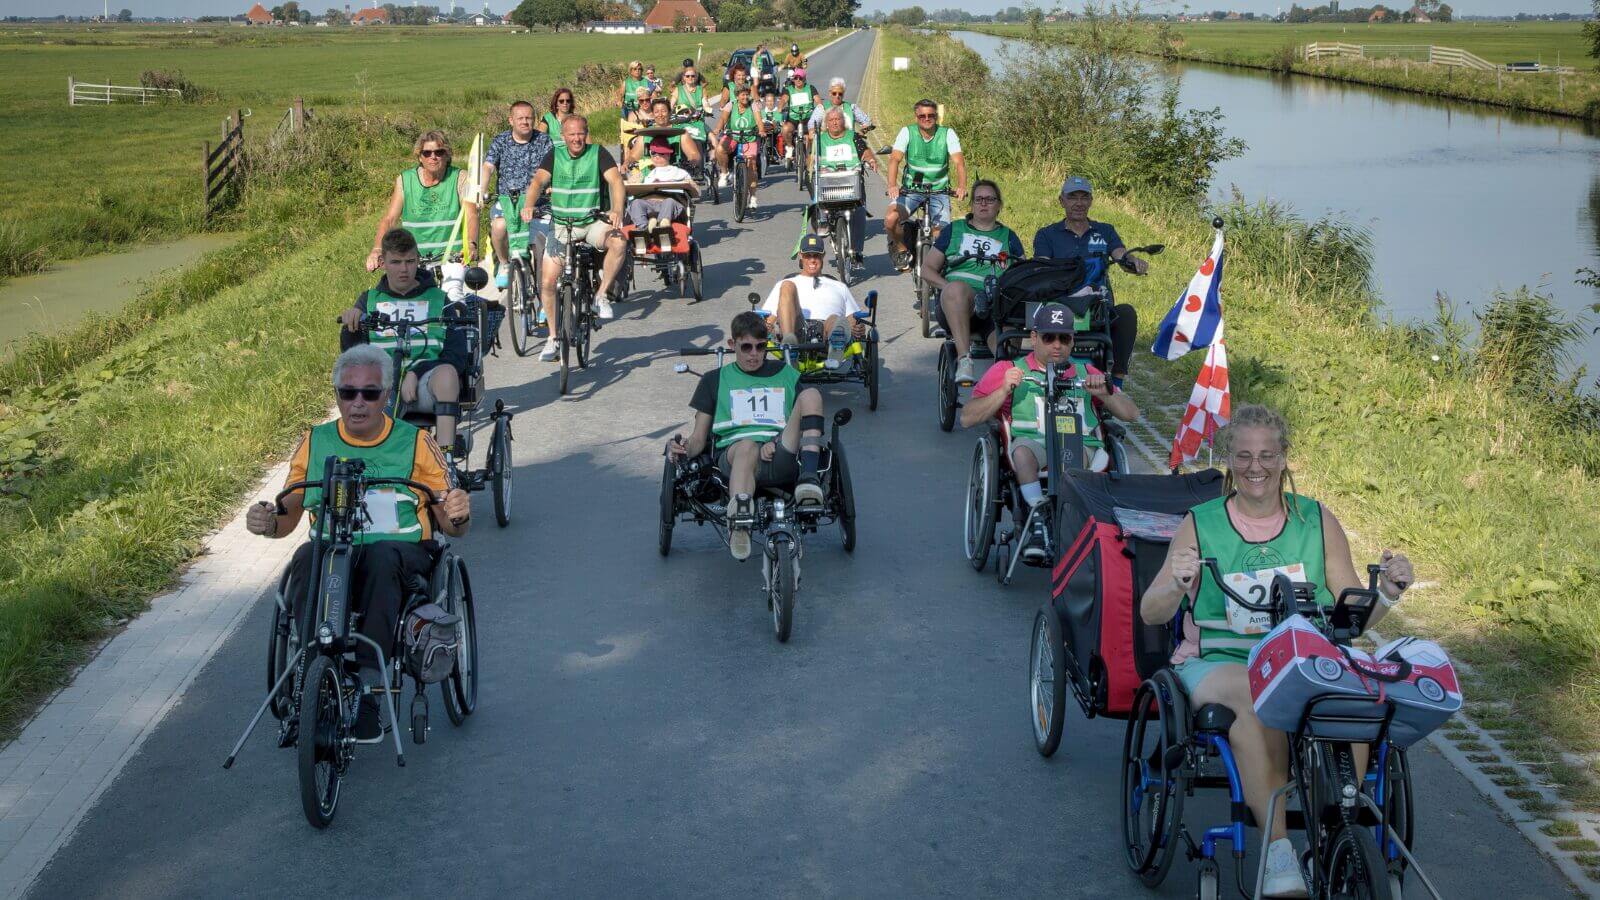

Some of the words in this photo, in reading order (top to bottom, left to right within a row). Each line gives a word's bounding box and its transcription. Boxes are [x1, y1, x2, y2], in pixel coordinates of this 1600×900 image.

[833, 148, 844, 157] 21
[972, 239, 991, 251] 56
[391, 308, 415, 322] 15
[747, 395, 768, 412] 11
